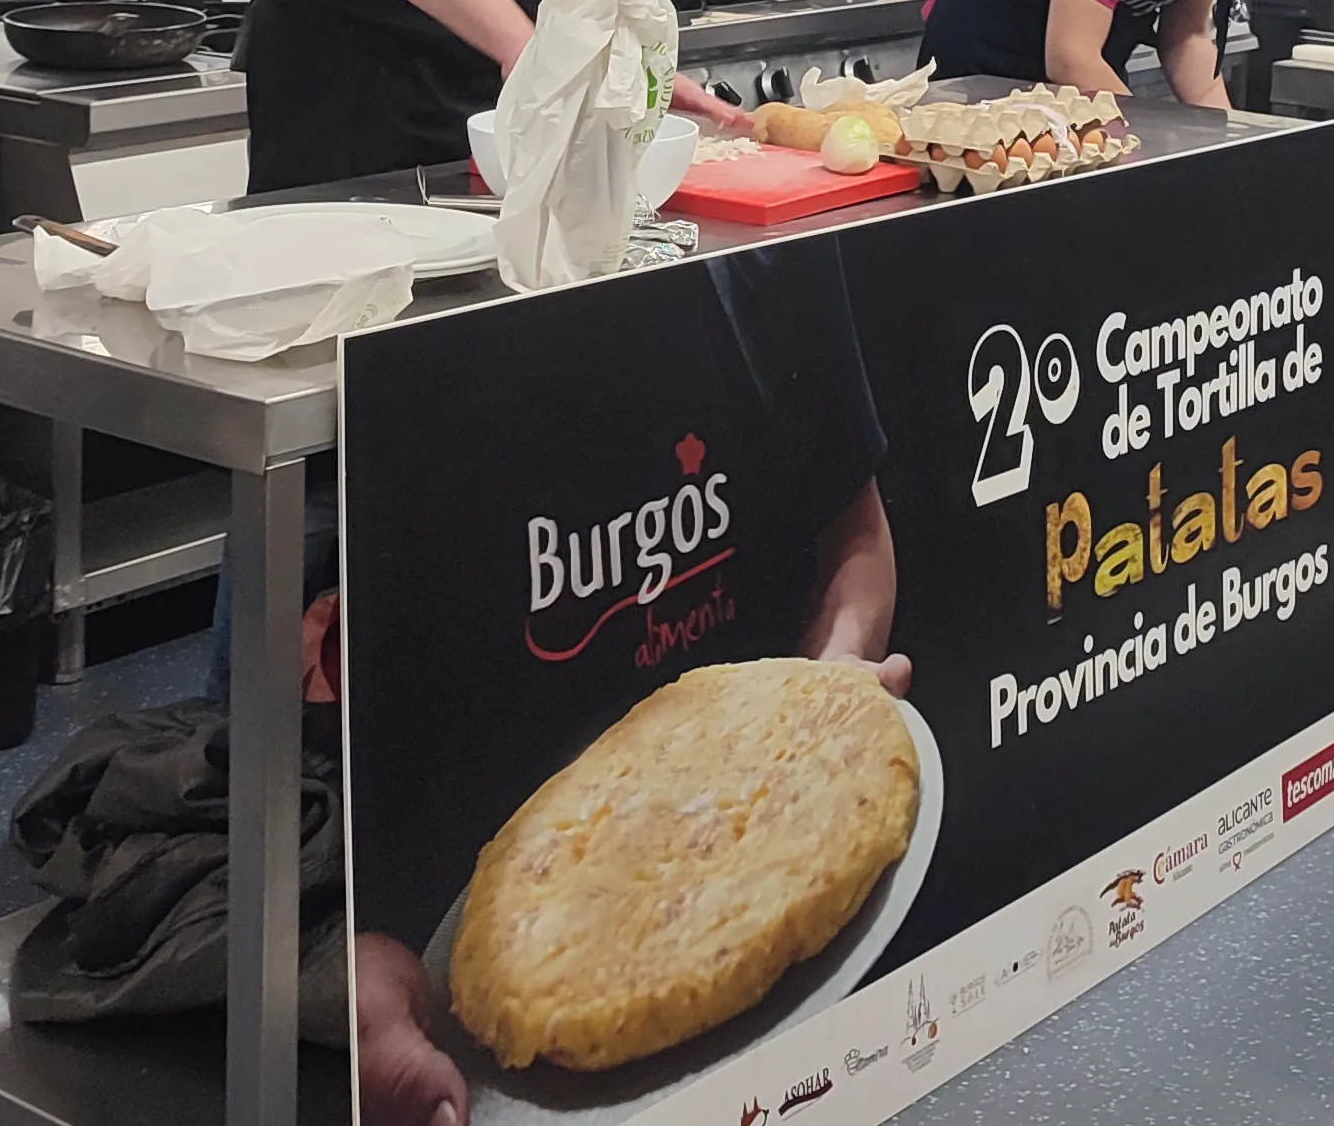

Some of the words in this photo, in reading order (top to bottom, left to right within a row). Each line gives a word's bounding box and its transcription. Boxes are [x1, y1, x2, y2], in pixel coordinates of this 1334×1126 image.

[1096, 267, 1324, 384] Campeonato
[1101, 383, 1150, 460] de
[1156, 339, 1276, 439] Tortilla
[1284, 323, 1323, 393] de
[527, 473, 730, 613] Burgos
[990, 611, 1167, 749] Provincia
[1173, 583, 1217, 655] de
[1222, 544, 1329, 633] Burgos
[1153, 833, 1209, 885] Cámara
